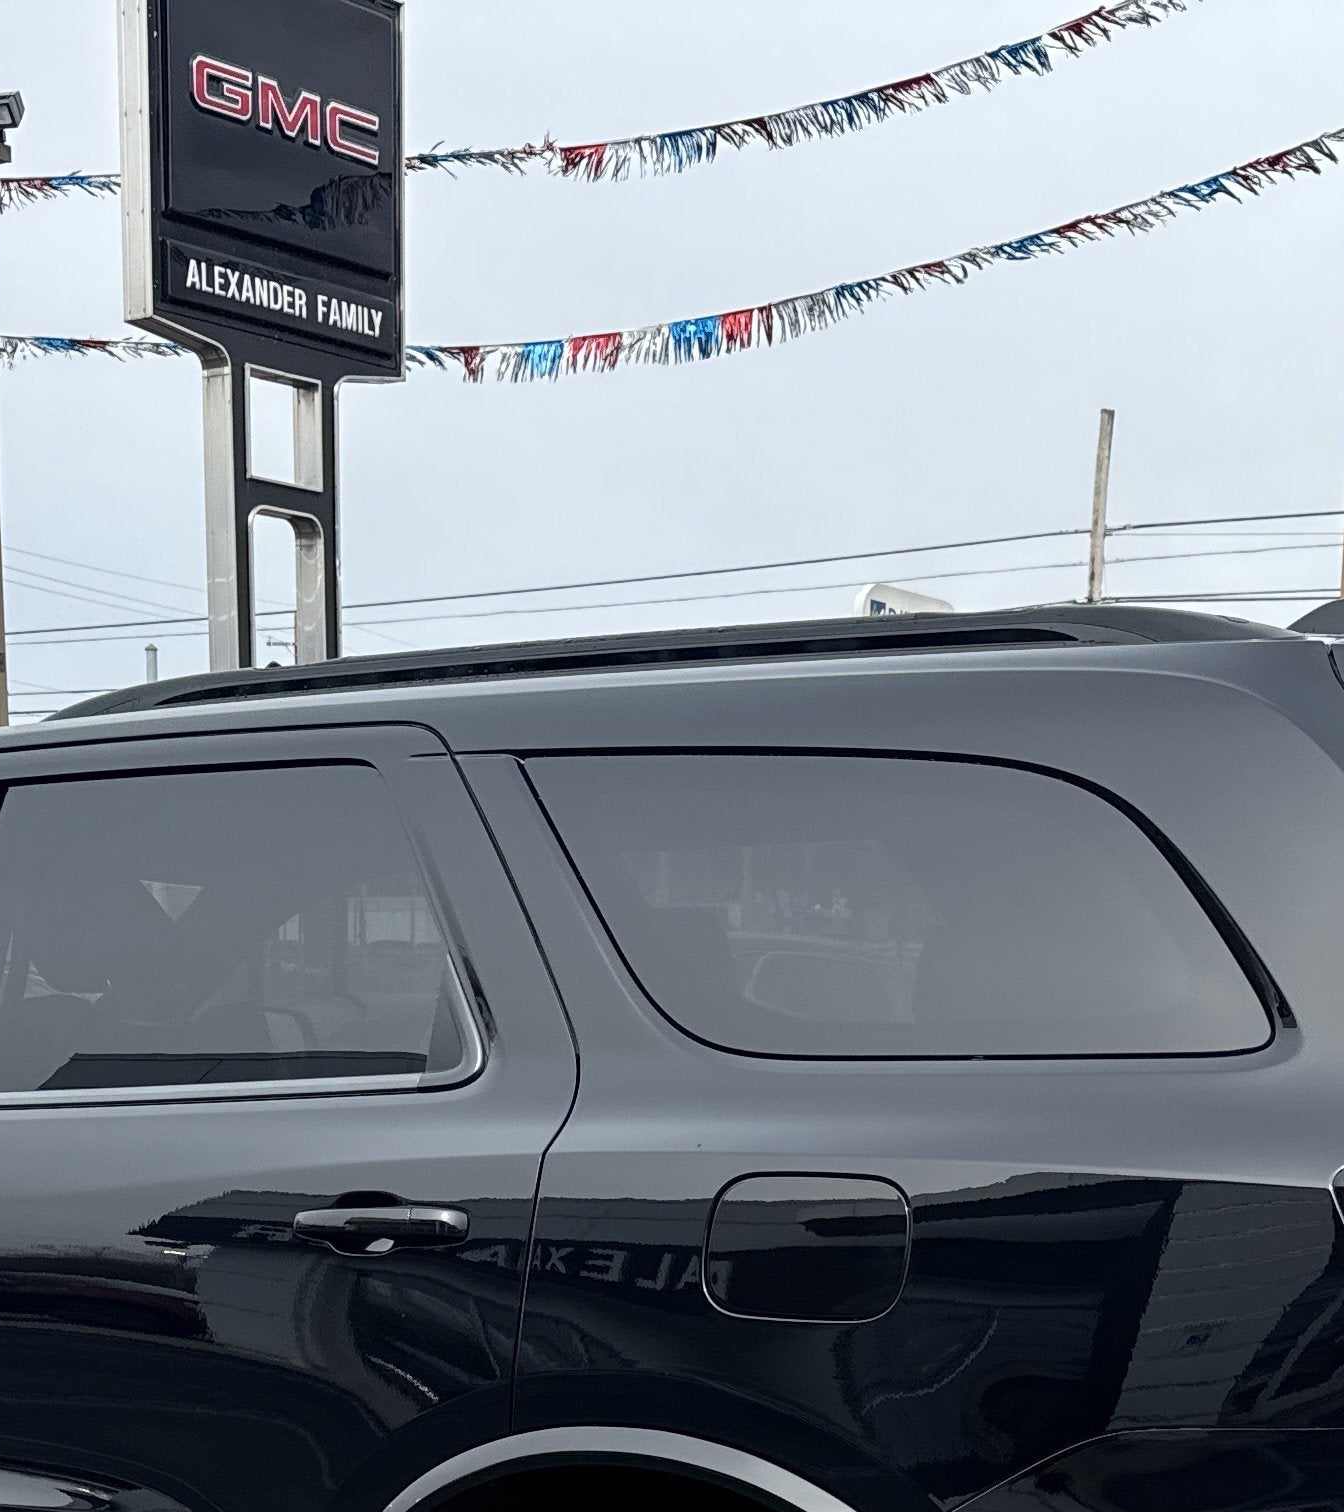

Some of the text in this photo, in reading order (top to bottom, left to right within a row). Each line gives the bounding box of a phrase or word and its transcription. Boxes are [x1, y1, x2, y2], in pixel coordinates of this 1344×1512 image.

[192, 54, 379, 165] GMC
[186, 259, 383, 339] ALEXANDER FAMILY
